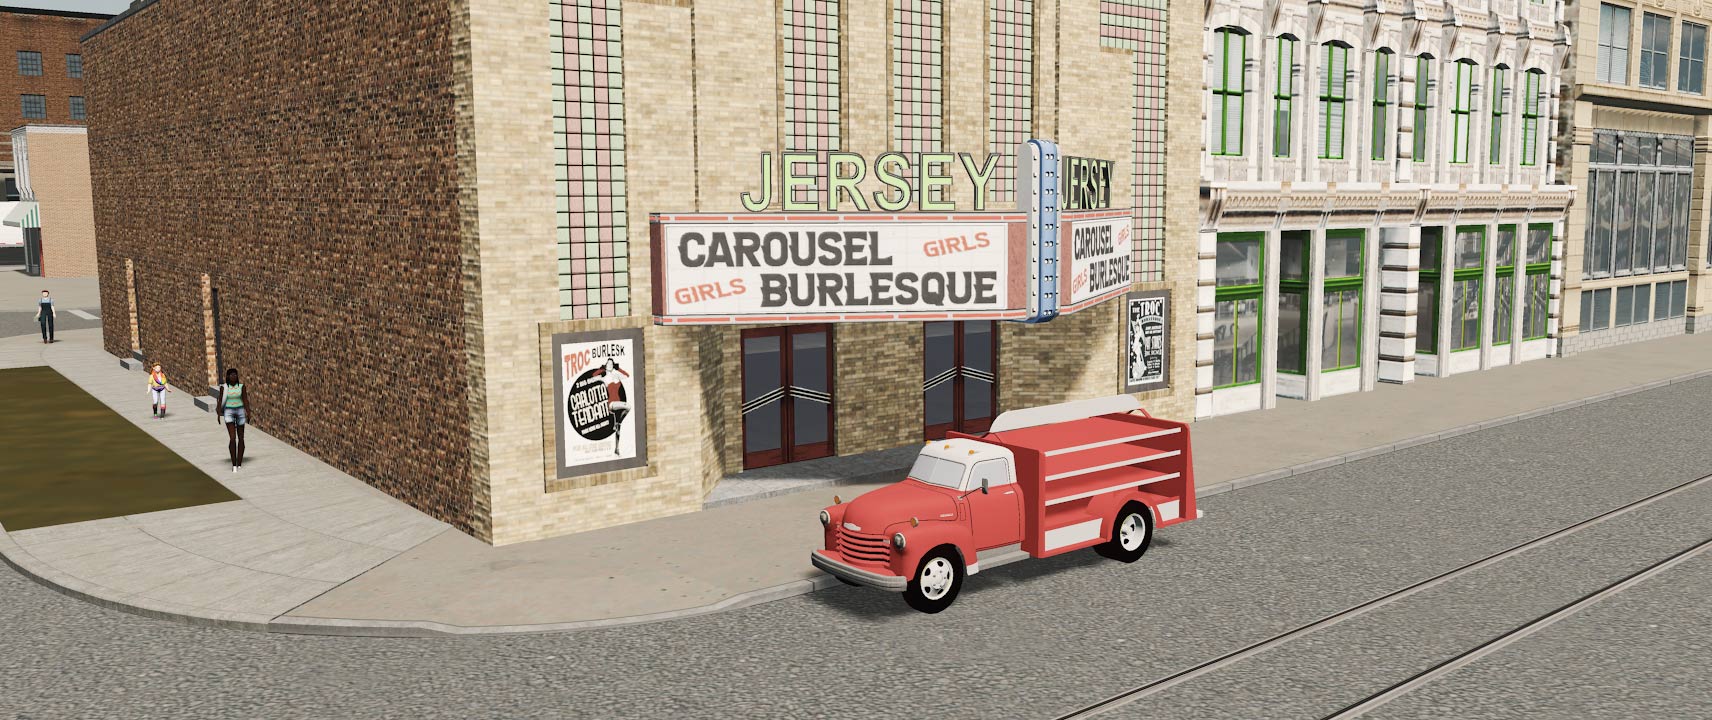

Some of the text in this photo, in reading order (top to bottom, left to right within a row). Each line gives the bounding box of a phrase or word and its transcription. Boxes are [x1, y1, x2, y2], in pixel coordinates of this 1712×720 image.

[740, 151, 1000, 212] JERSEY
[1062, 156, 1115, 210] JERSEY
[678, 231, 893, 267] CAROUSEL
[923, 231, 991, 257] GIRLS
[1074, 225, 1114, 260] CAROUSEL
[674, 278, 747, 305] GIRLS
[760, 271, 997, 307] BURLESQUE
[1072, 268, 1088, 294] GIRLS
[1089, 255, 1130, 292] BURLESQUE
[564, 344, 626, 381] TROC BURLESK
[570, 383, 609, 411] CARLOTTA
